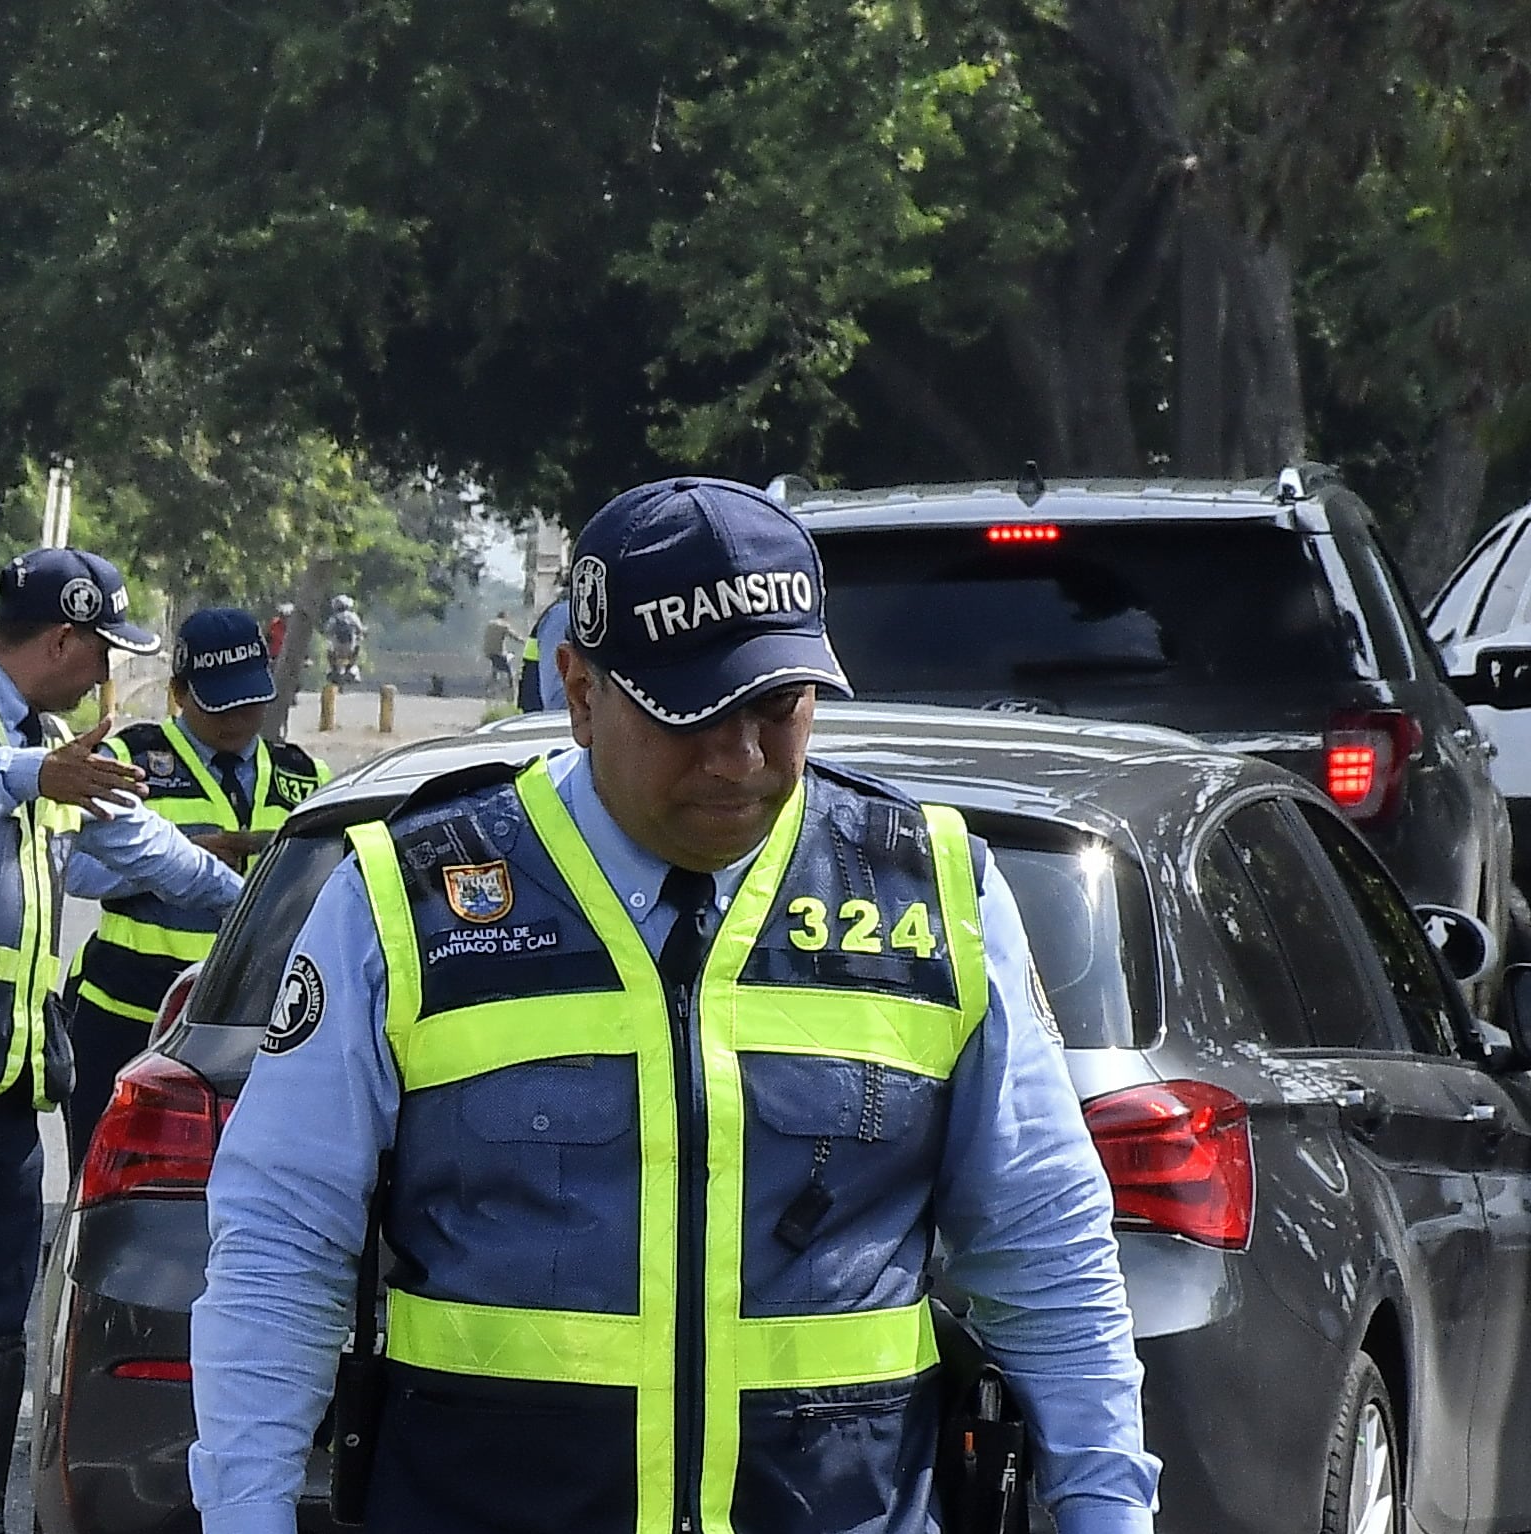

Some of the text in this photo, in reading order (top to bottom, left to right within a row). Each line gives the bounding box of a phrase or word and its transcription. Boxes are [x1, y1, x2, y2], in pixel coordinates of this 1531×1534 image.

[633, 571, 812, 642] TRANSITO
[193, 642, 261, 670] MOVILIDAD
[513, 926, 531, 938] DE
[788, 896, 937, 959] 324
[428, 932, 557, 965] SANTIAGO DE CALI
[260, 1038, 280, 1051] ALI
